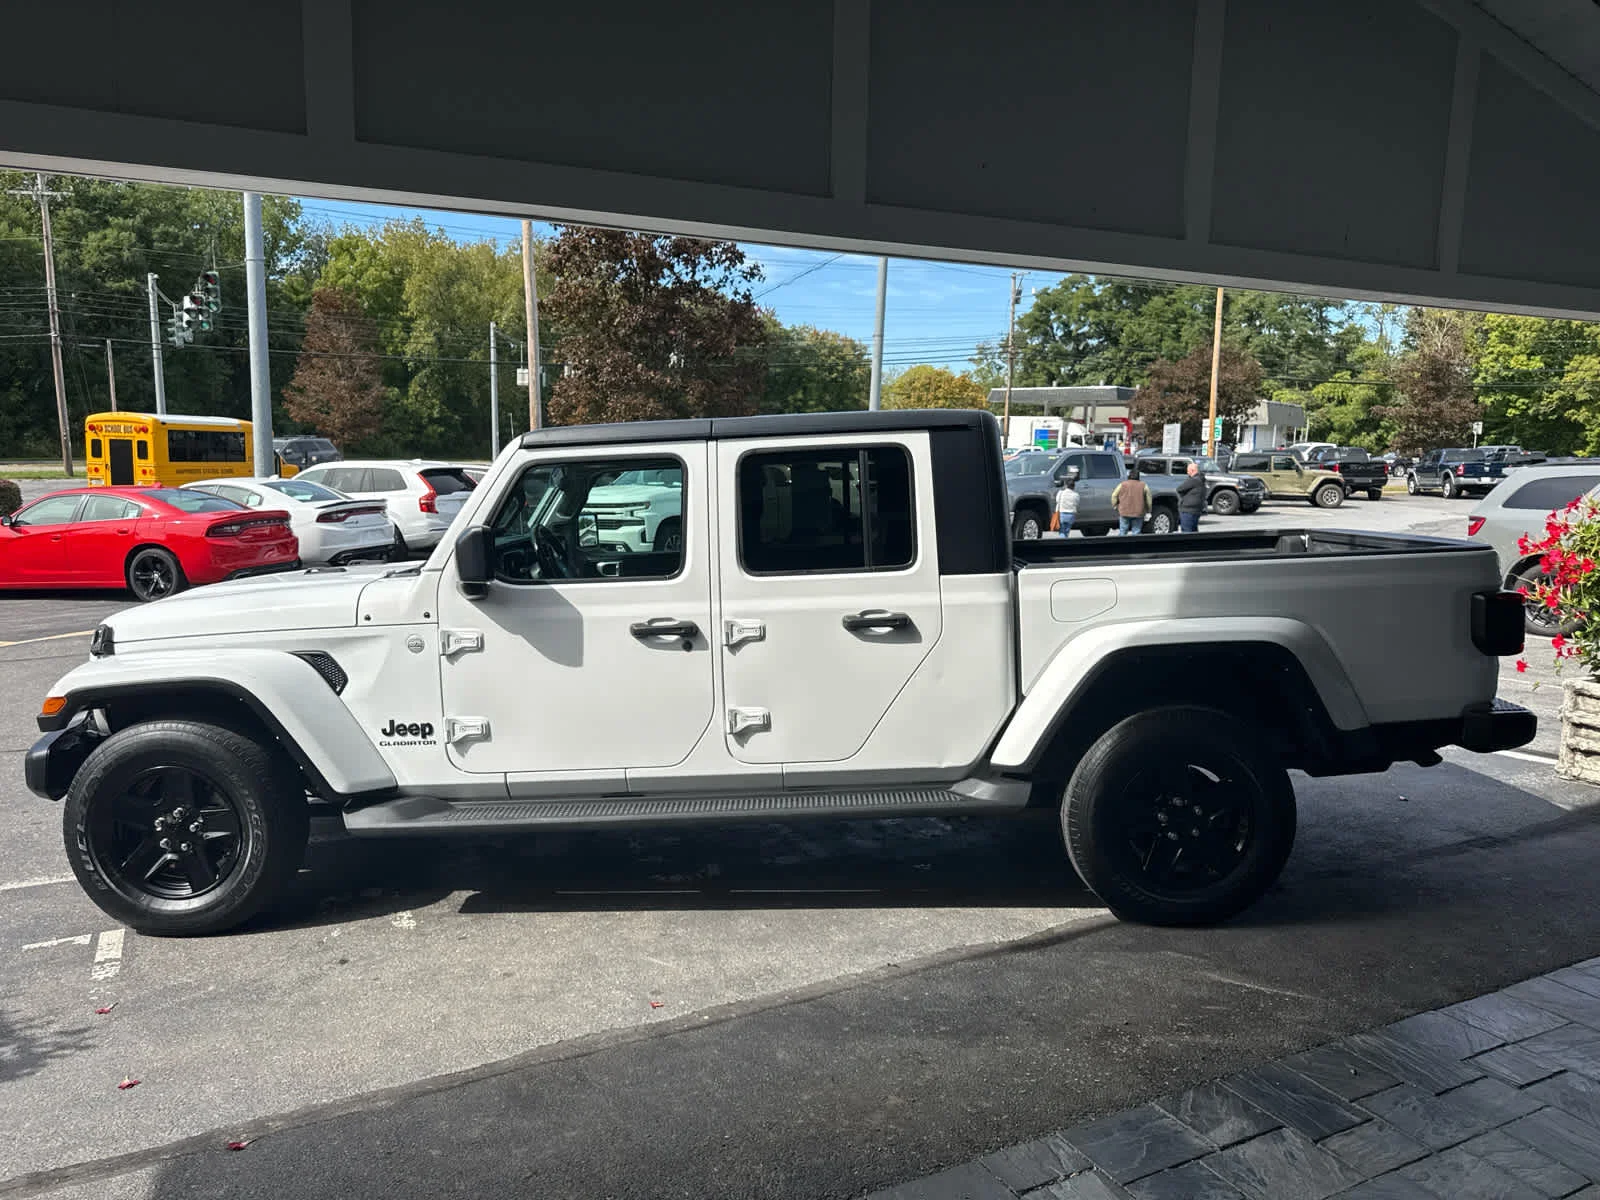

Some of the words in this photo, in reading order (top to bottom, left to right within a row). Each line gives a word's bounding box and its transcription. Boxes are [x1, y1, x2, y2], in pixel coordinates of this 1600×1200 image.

[104, 424, 122, 434] SCHOOL
[123, 425, 134, 434] BUS
[381, 719, 434, 740] Jeep
